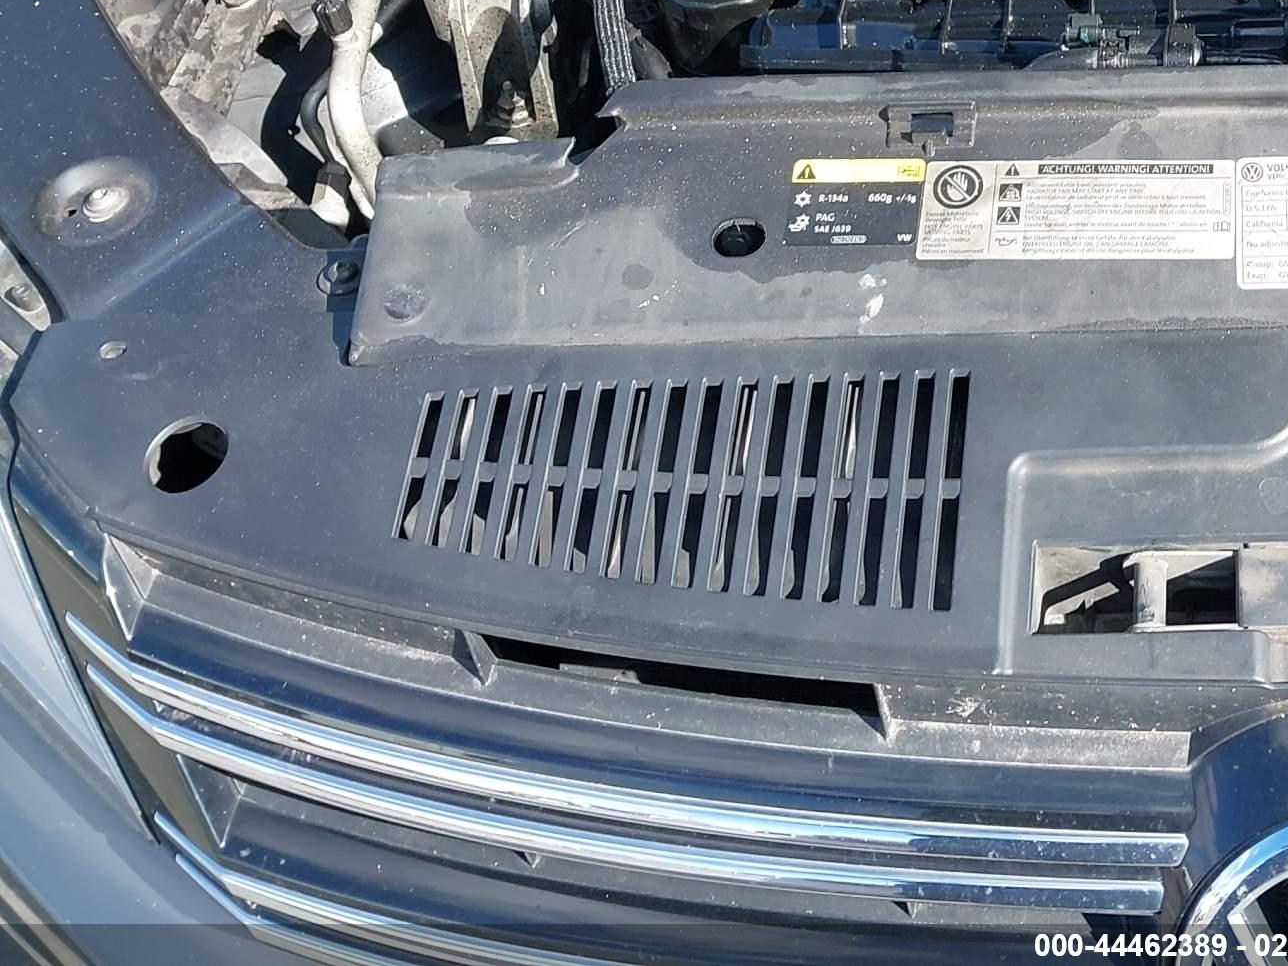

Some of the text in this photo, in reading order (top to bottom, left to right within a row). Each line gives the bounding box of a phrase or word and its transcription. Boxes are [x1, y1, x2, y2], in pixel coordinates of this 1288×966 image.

[1041, 163, 1211, 174] ACHTUNG! WARNING! ATTENTION!
[818, 193, 849, 203] R-134a
[868, 192, 893, 204] 660g
[815, 213, 836, 222] PAG
[814, 225, 830, 233] SAE
[897, 233, 912, 242] VW
